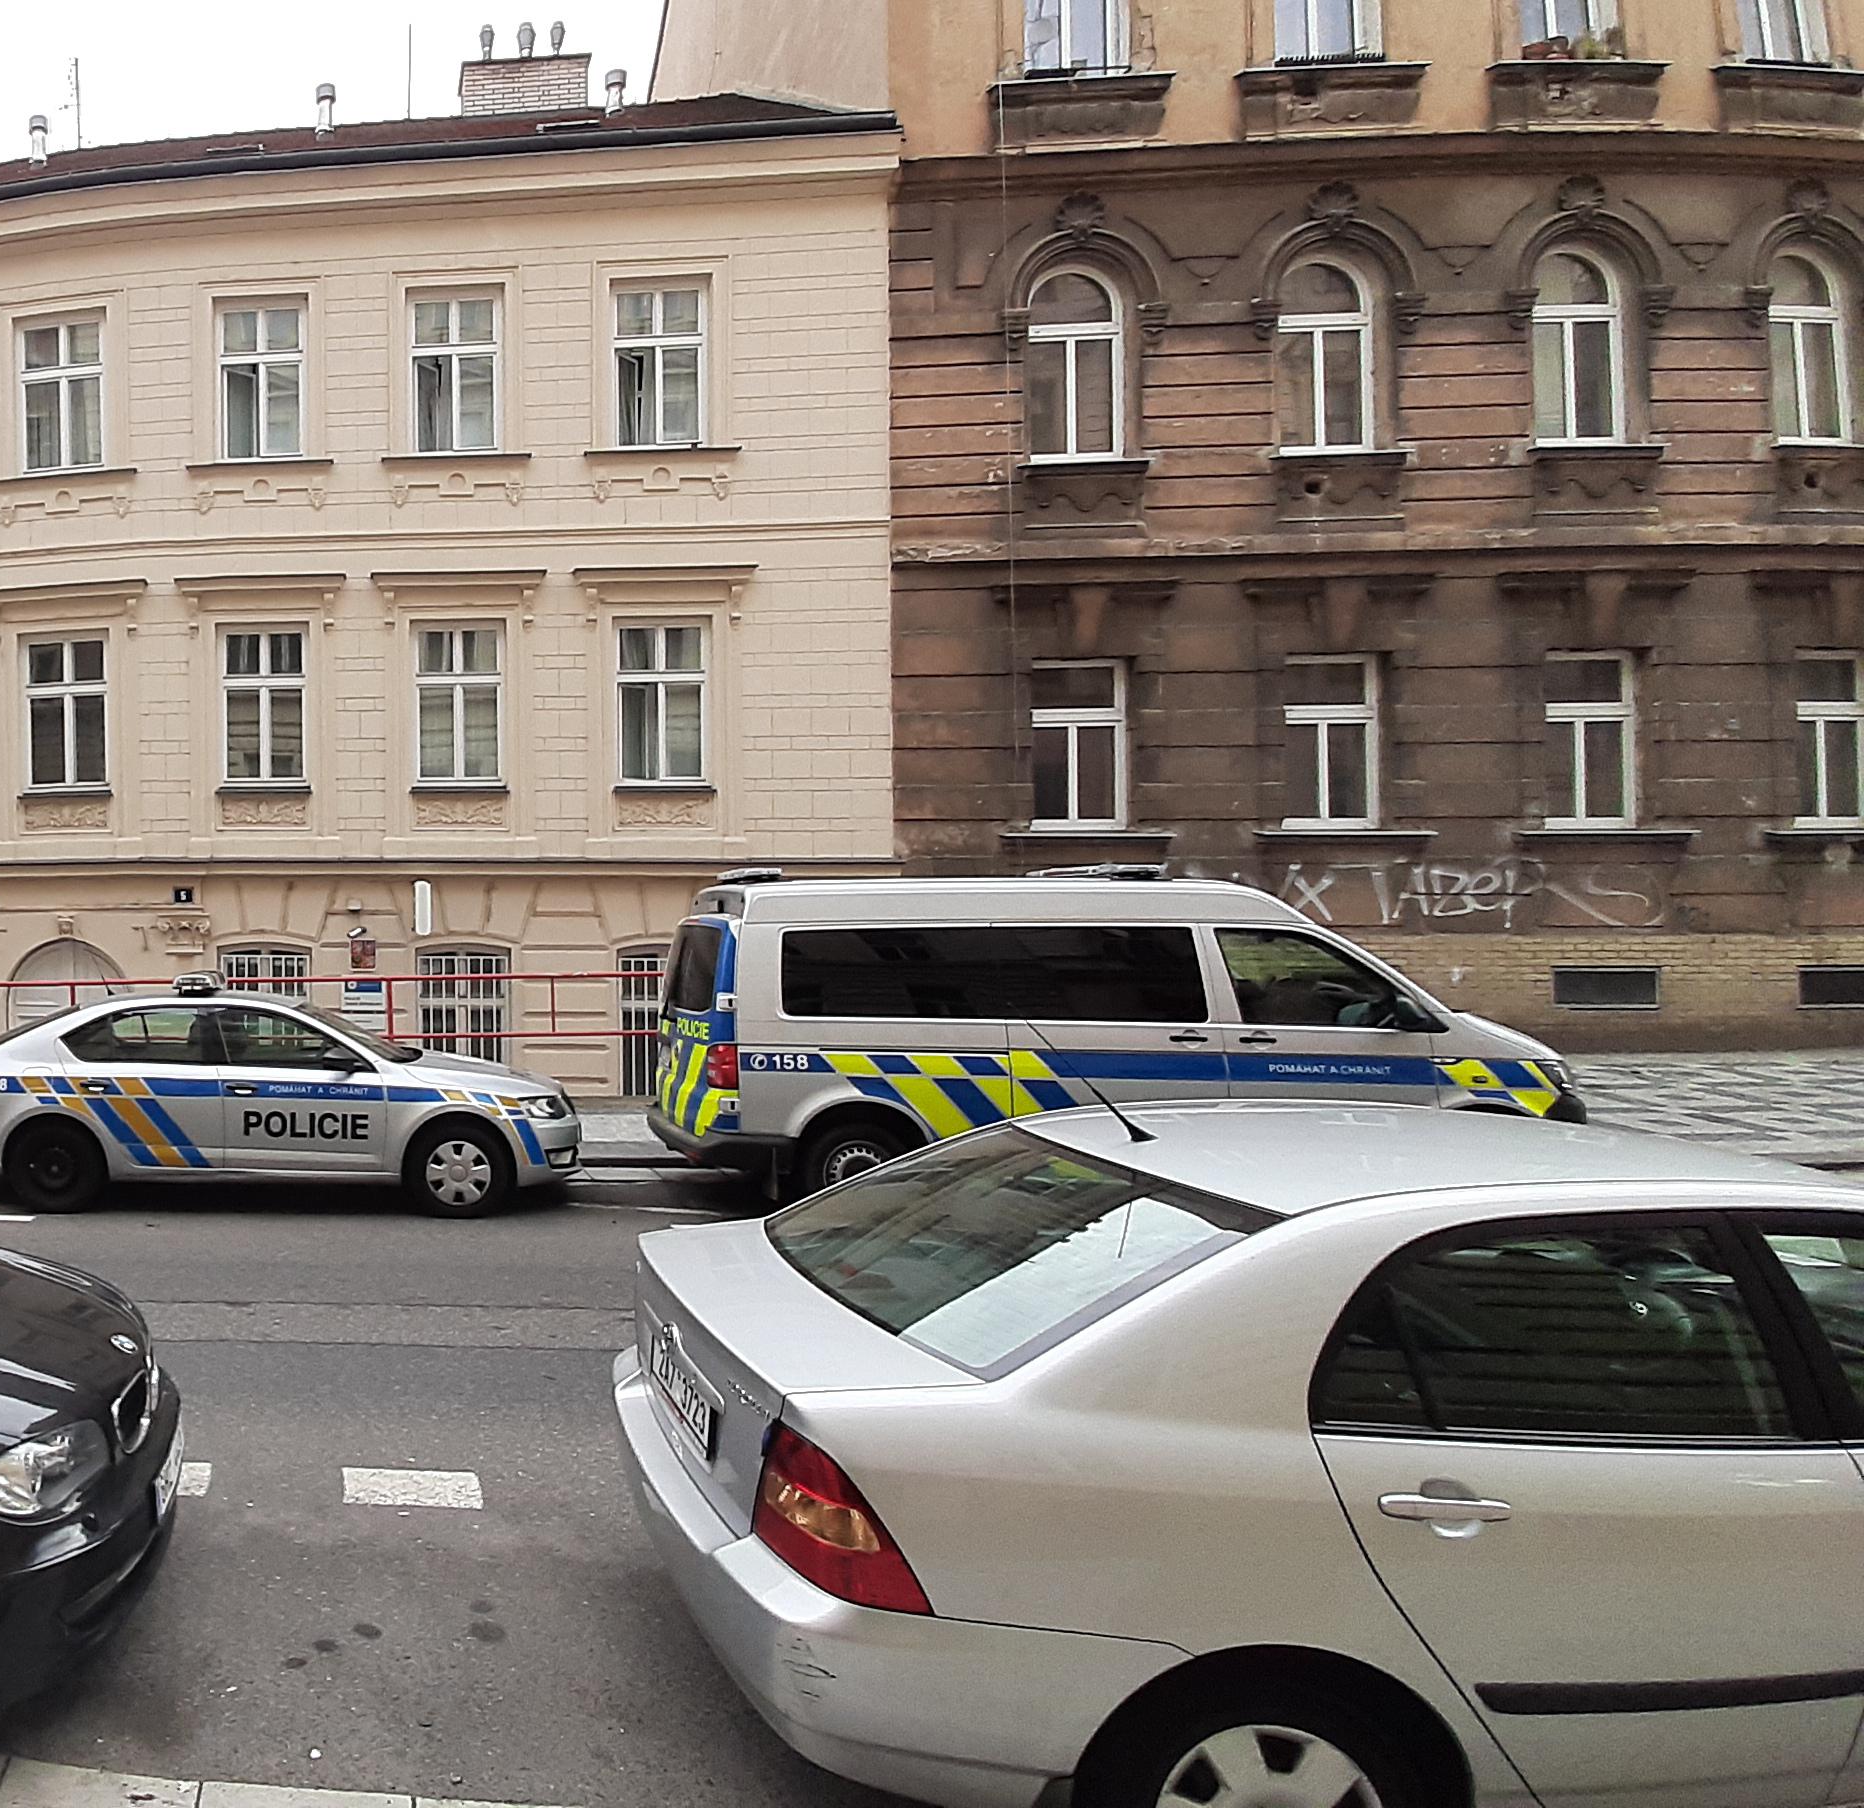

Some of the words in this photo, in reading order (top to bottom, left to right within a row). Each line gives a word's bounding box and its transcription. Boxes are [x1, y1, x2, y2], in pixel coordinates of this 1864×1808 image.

[677, 1017, 710, 1041] POLICIE
[772, 1054, 809, 1070] 158
[243, 1110, 369, 1140] POLICIE
[681, 1377, 707, 1436] 3723
